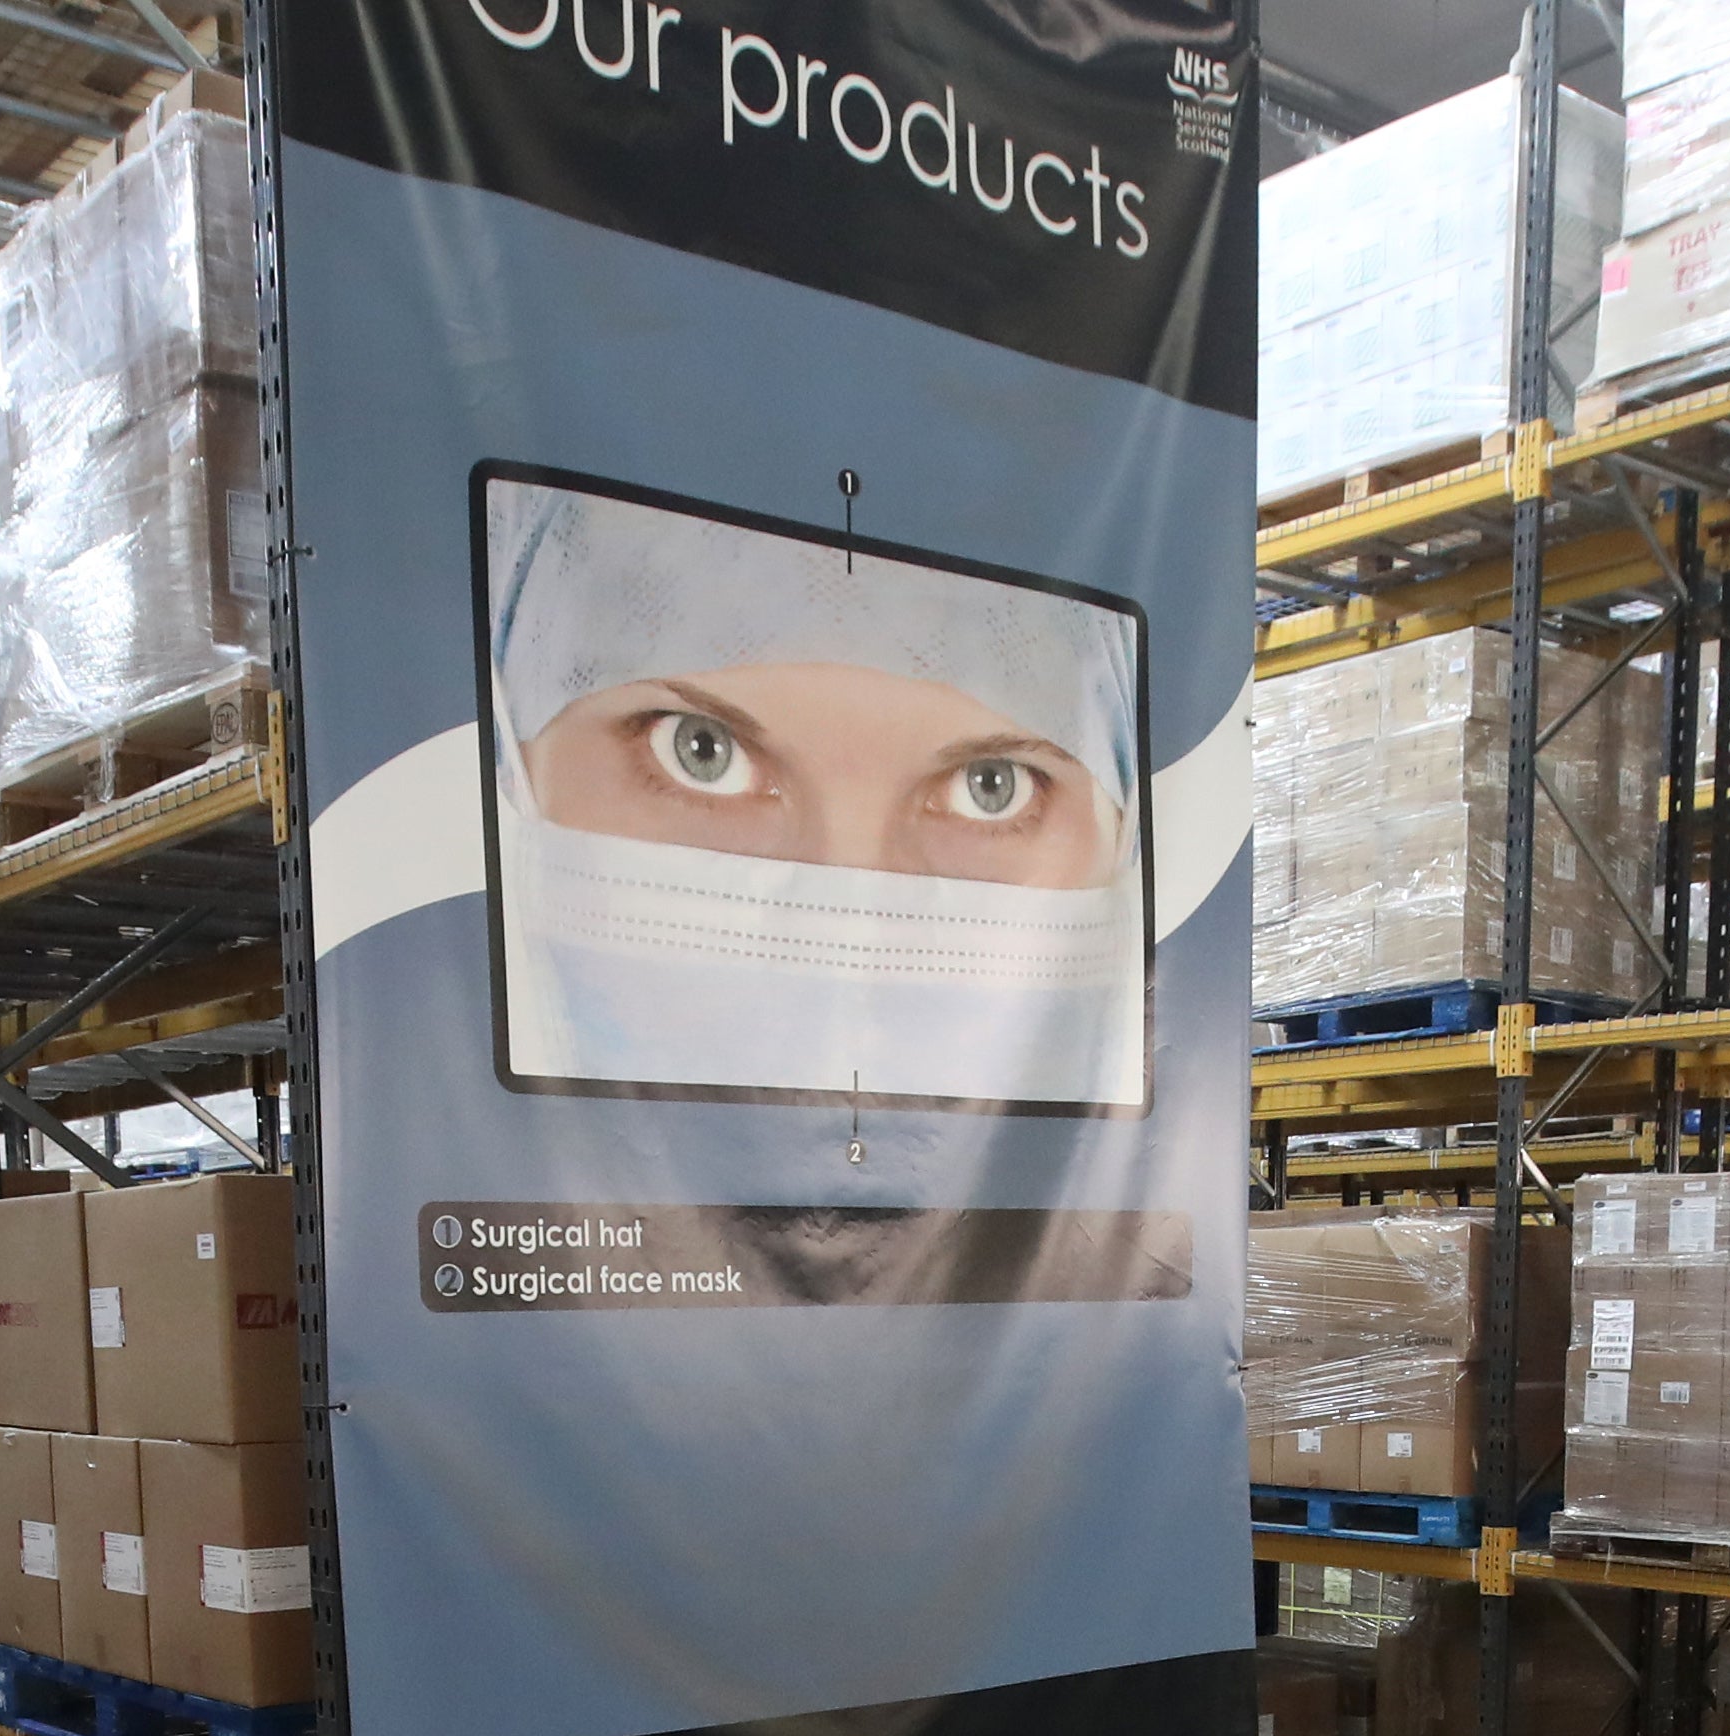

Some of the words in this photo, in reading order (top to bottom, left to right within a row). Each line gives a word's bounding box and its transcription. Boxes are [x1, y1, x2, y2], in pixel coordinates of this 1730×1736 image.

[1174, 47, 1230, 91] NHS
[1173, 99, 1232, 128] National
[721, 27, 1150, 259] products
[1175, 117, 1230, 147] Services
[1175, 133, 1231, 164] Scotland
[471, 1218, 591, 1254] Surgical
[599, 1218, 643, 1248] hat
[471, 1265, 592, 1301] Surgical
[599, 1264, 663, 1295] face
[671, 1265, 743, 1294] mask
